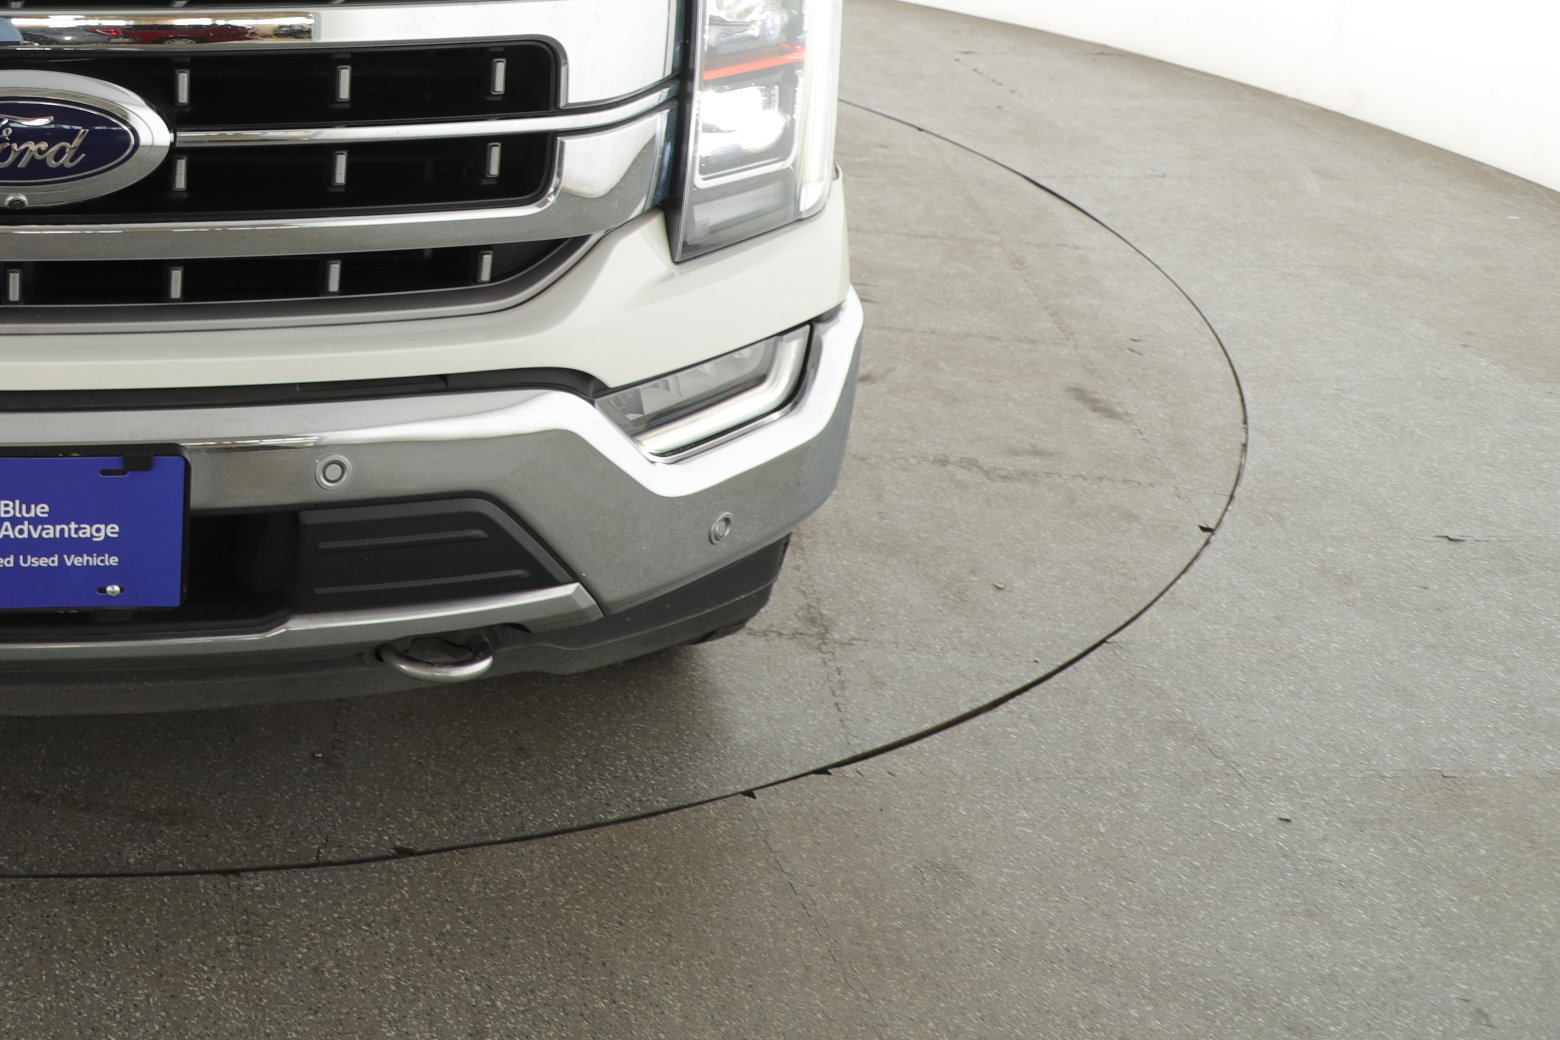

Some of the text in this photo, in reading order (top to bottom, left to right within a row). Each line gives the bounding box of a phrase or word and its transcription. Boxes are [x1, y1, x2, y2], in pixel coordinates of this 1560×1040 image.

[0, 500, 49, 518] Blue
[19, 554, 59, 568] Used
[63, 553, 119, 567] Vehicle
